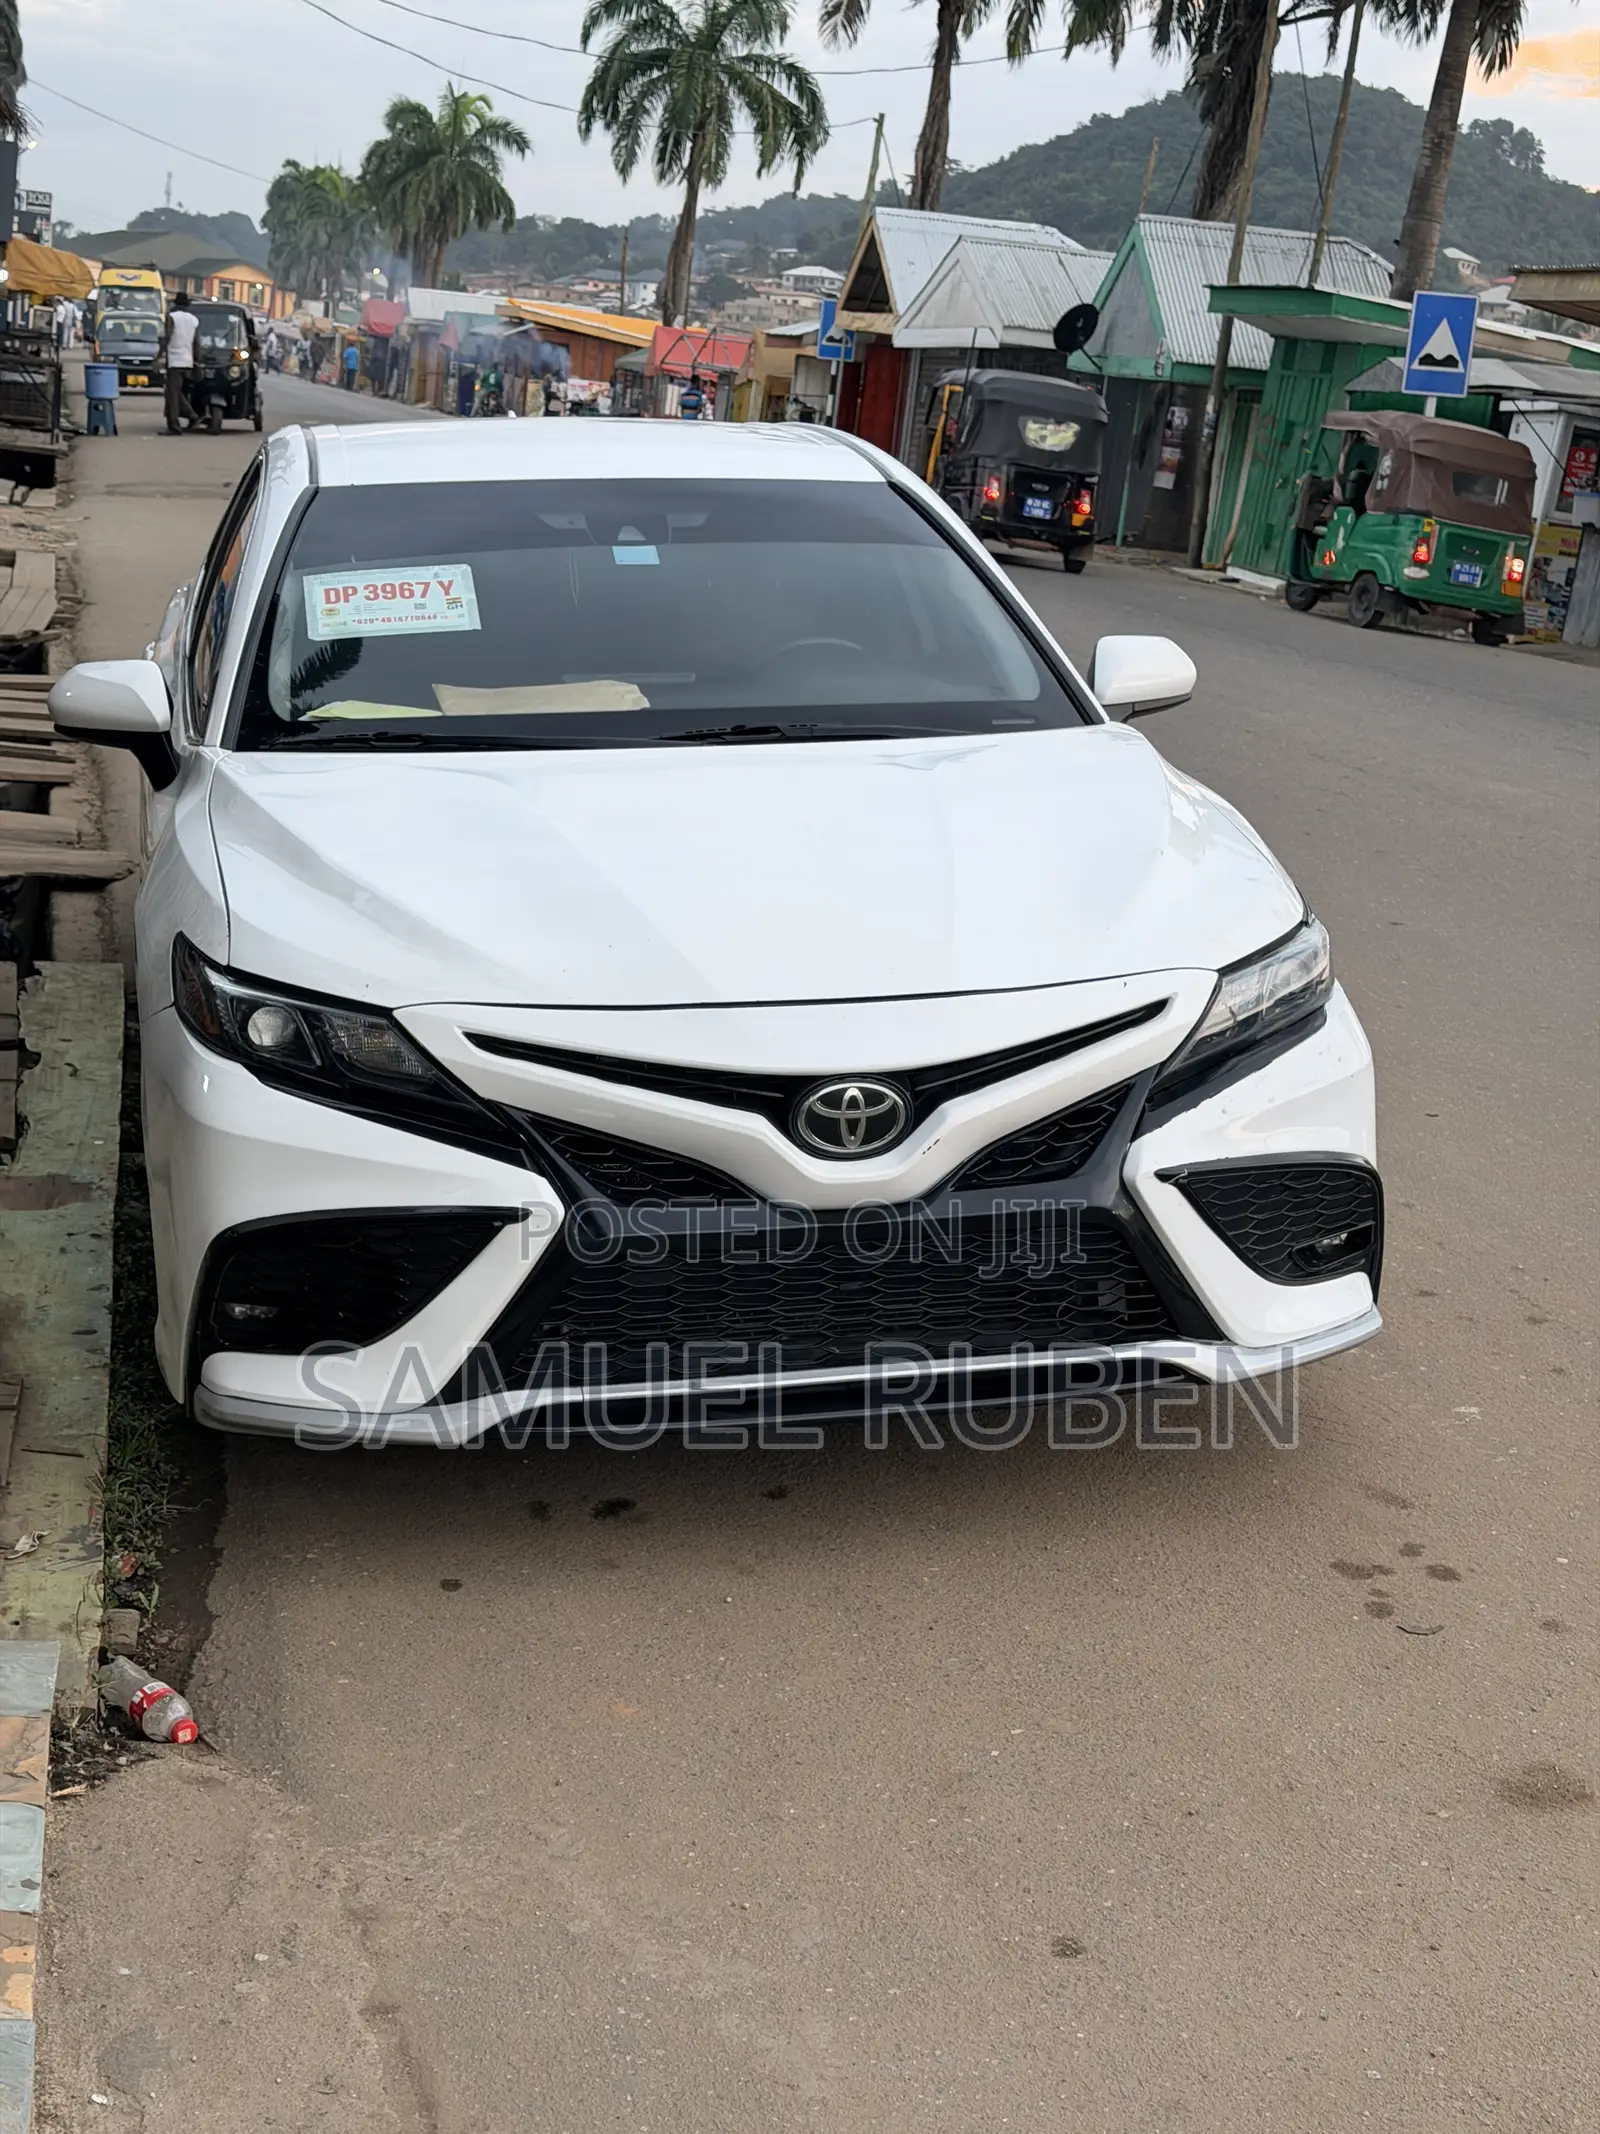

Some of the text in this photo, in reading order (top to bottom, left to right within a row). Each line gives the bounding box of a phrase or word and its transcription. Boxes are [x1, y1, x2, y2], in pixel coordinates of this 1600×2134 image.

[323, 580, 454, 604] DP 3967 Y
